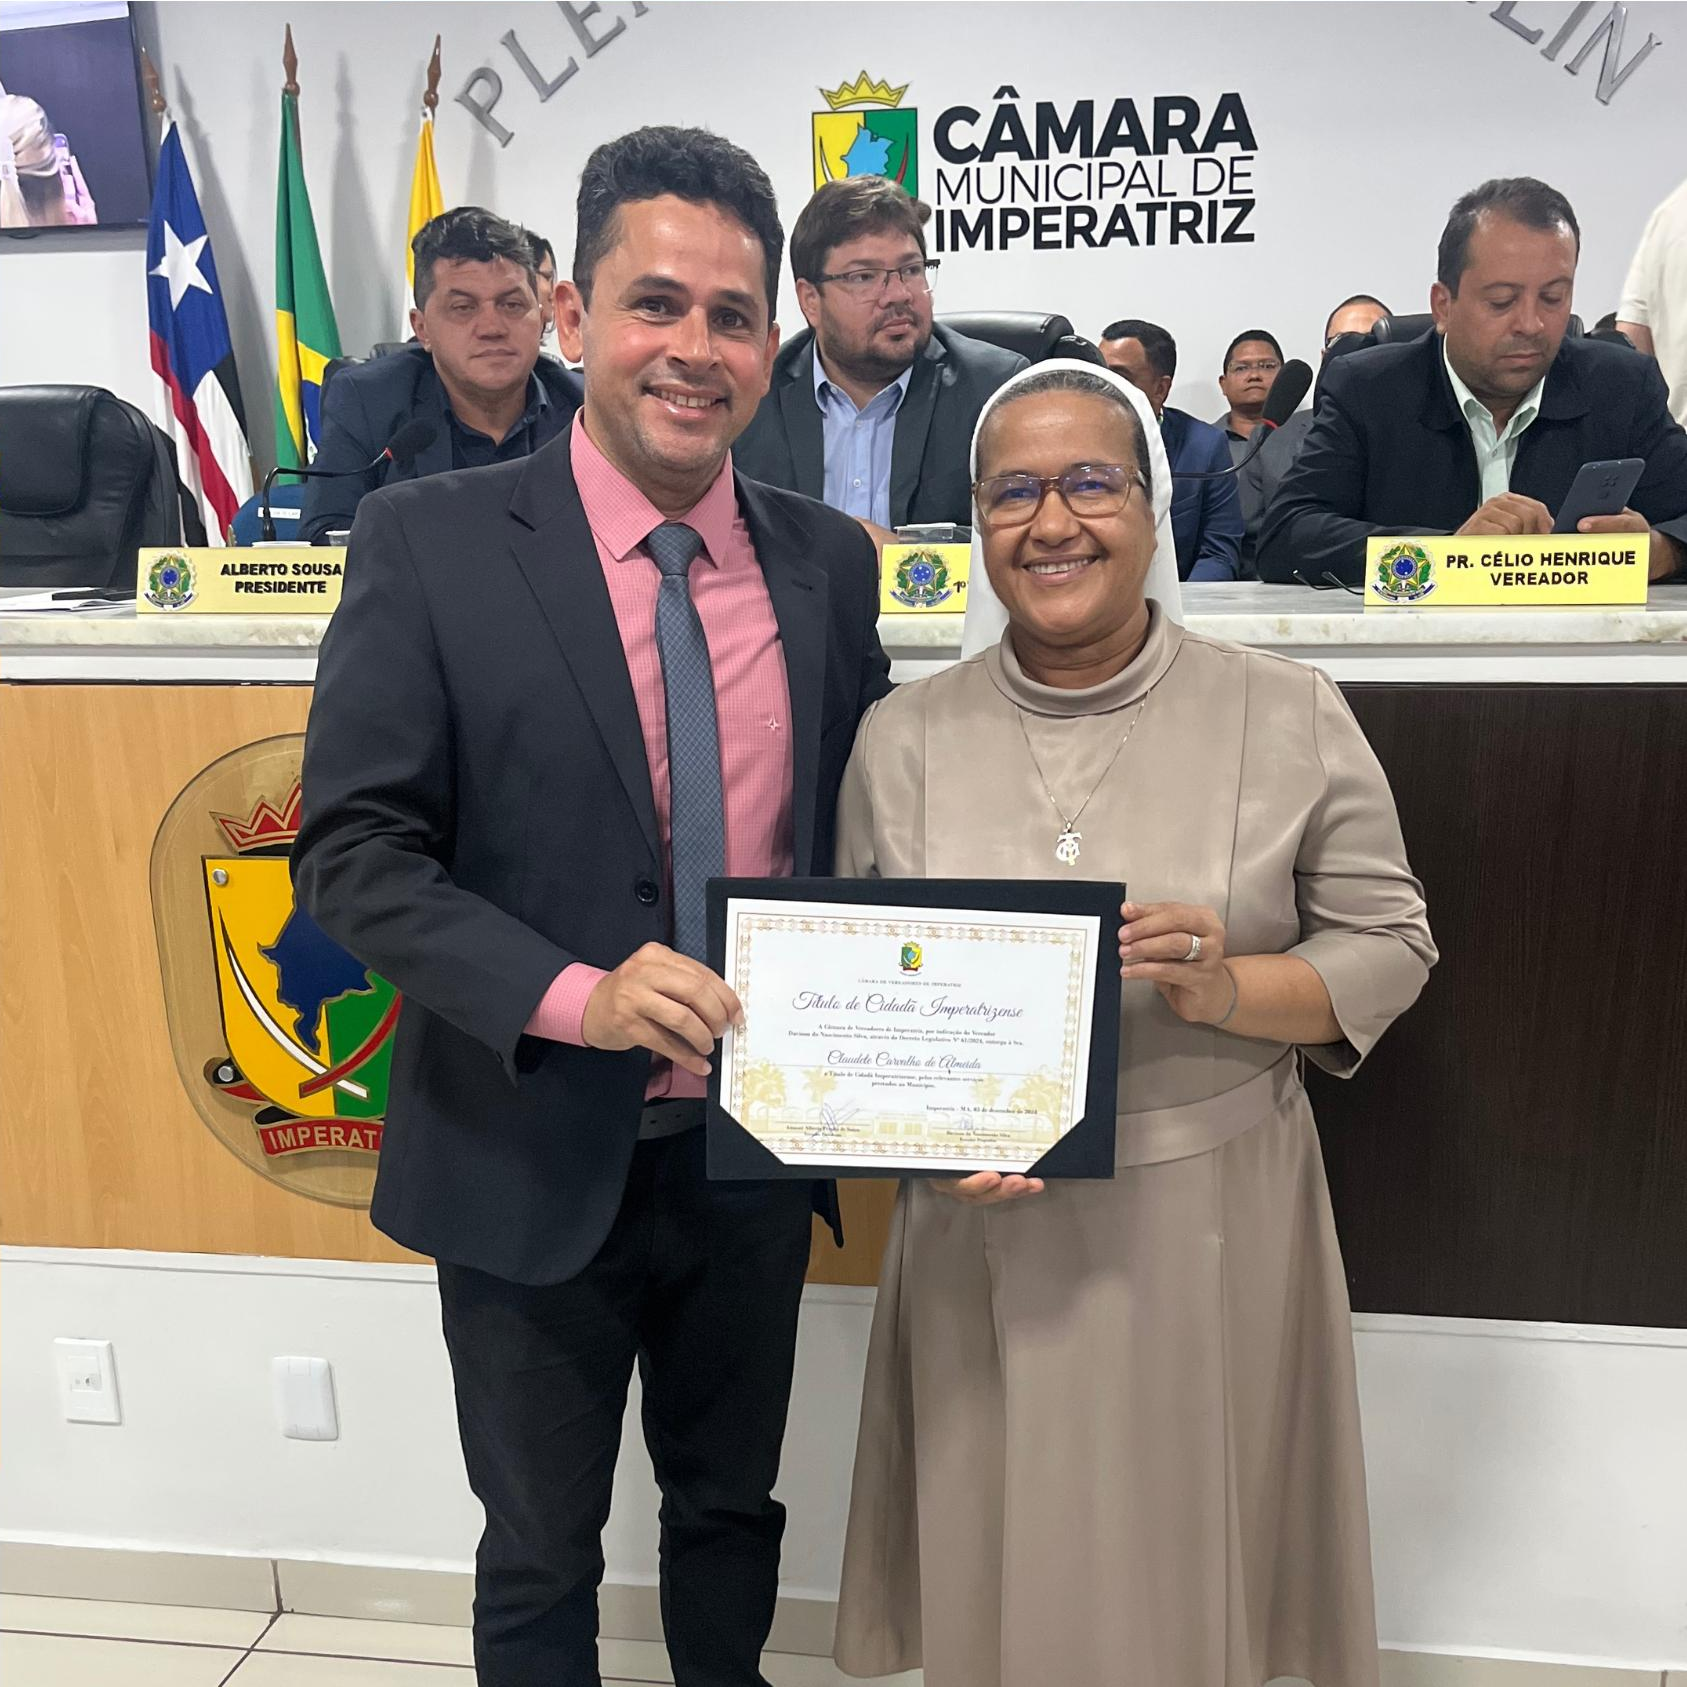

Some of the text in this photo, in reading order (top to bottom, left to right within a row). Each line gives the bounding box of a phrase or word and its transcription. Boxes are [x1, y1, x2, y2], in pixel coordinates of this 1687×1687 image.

[933, 85, 1258, 164] CÂMARA
[936, 156, 1255, 205] MUNICIPAL DE
[936, 198, 1256, 252] IMPERATRIZ
[1446, 551, 1636, 568] PR. CÉLIO HENRIQUE
[220, 564, 342, 576] ALBERTO SOUSA
[1490, 572, 1588, 586] VEREADOR
[235, 581, 327, 594] PRESIDENTE
[792, 991, 1023, 1022] Título de Cidadã Imperatrizense
[925, 1056, 935, 1067] de
[938, 1054, 981, 1070] Almeida
[268, 1126, 383, 1150] IMPERAT
